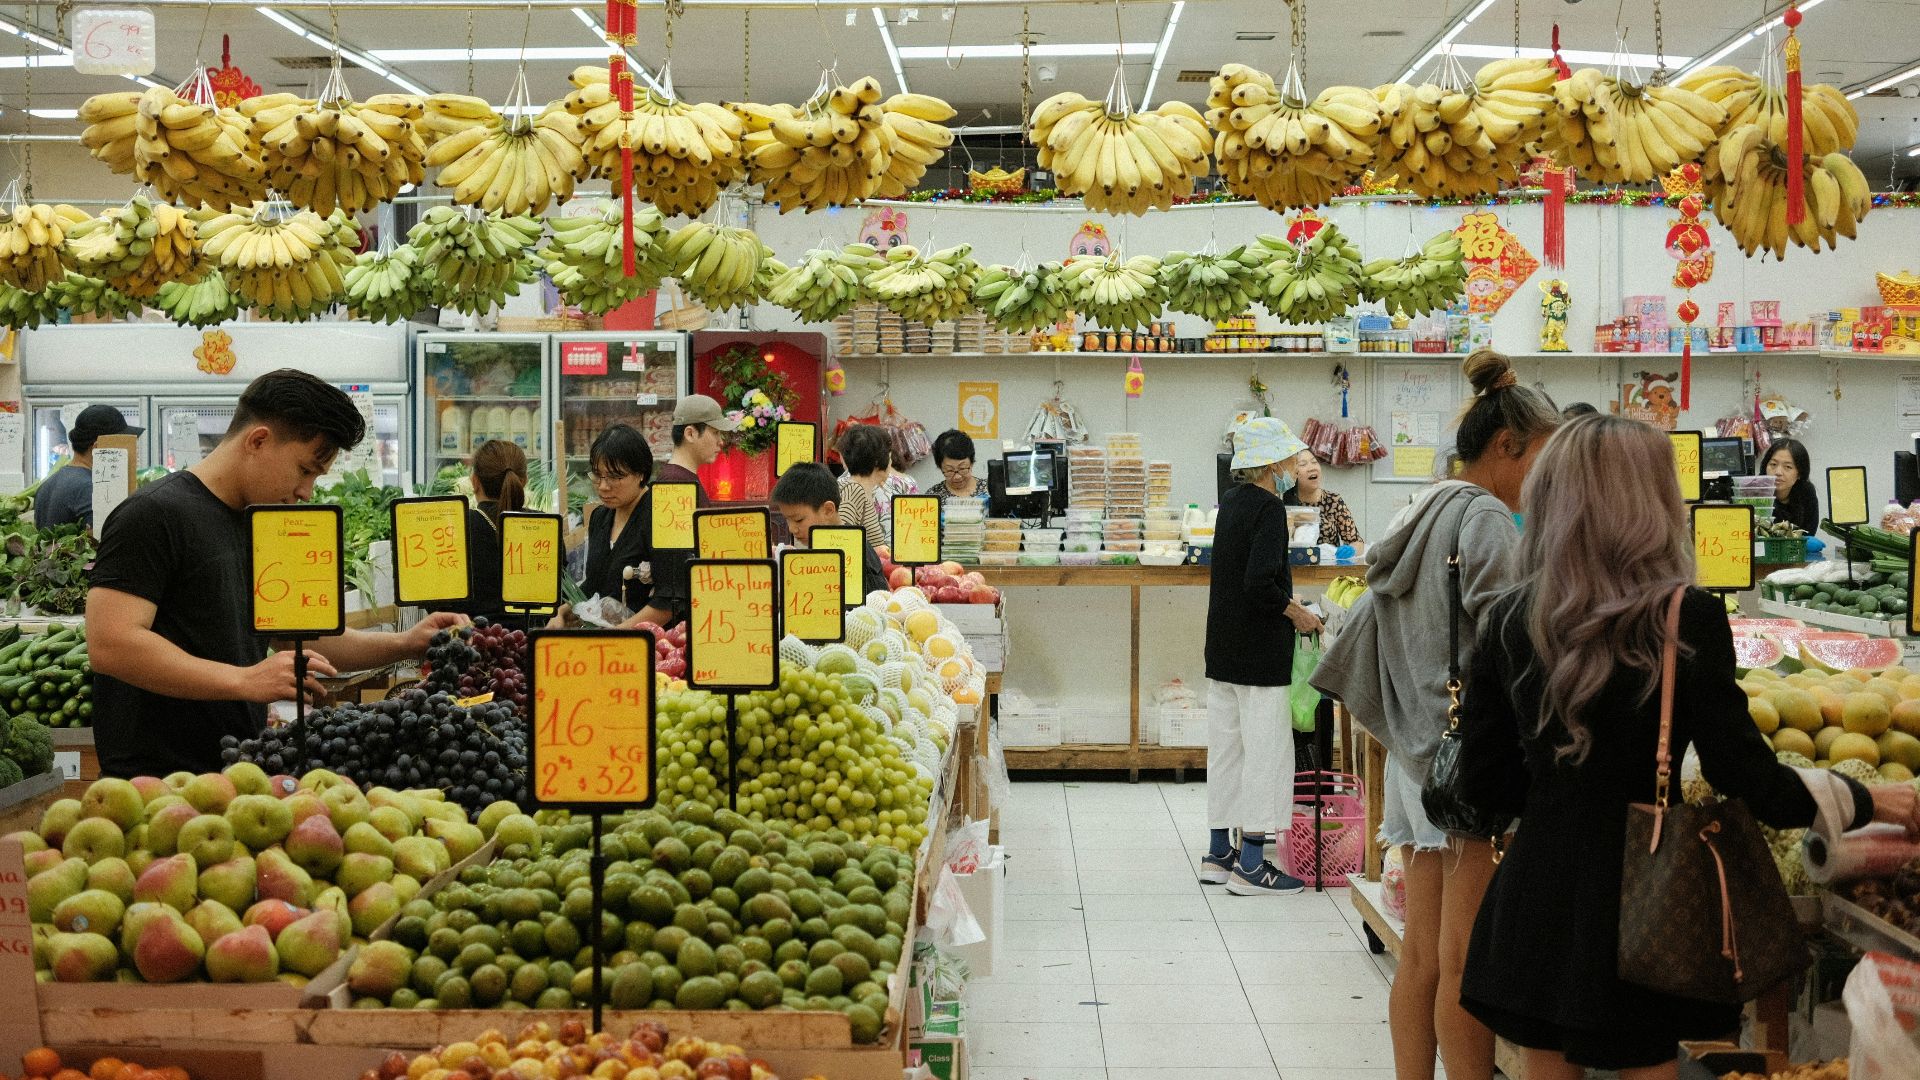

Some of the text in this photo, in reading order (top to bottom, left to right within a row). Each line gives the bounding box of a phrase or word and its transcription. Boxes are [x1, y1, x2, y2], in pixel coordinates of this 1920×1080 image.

[85, 20, 113, 59] 6
[899, 500, 935, 519] Papple
[283, 517, 305, 527] Pear
[709, 514, 756, 531] Grapes
[403, 525, 455, 568] 13 99
[1699, 536, 1724, 557] 13
[436, 556, 458, 569] KG
[505, 539, 551, 575] 11 99
[789, 557, 838, 575] Guava
[1731, 554, 1750, 566] KG
[255, 550, 333, 603] 6 99
[607, 688, 640, 707] 99
[1259, 872, 1279, 887] N
[928, 1054, 951, 1062] Class
